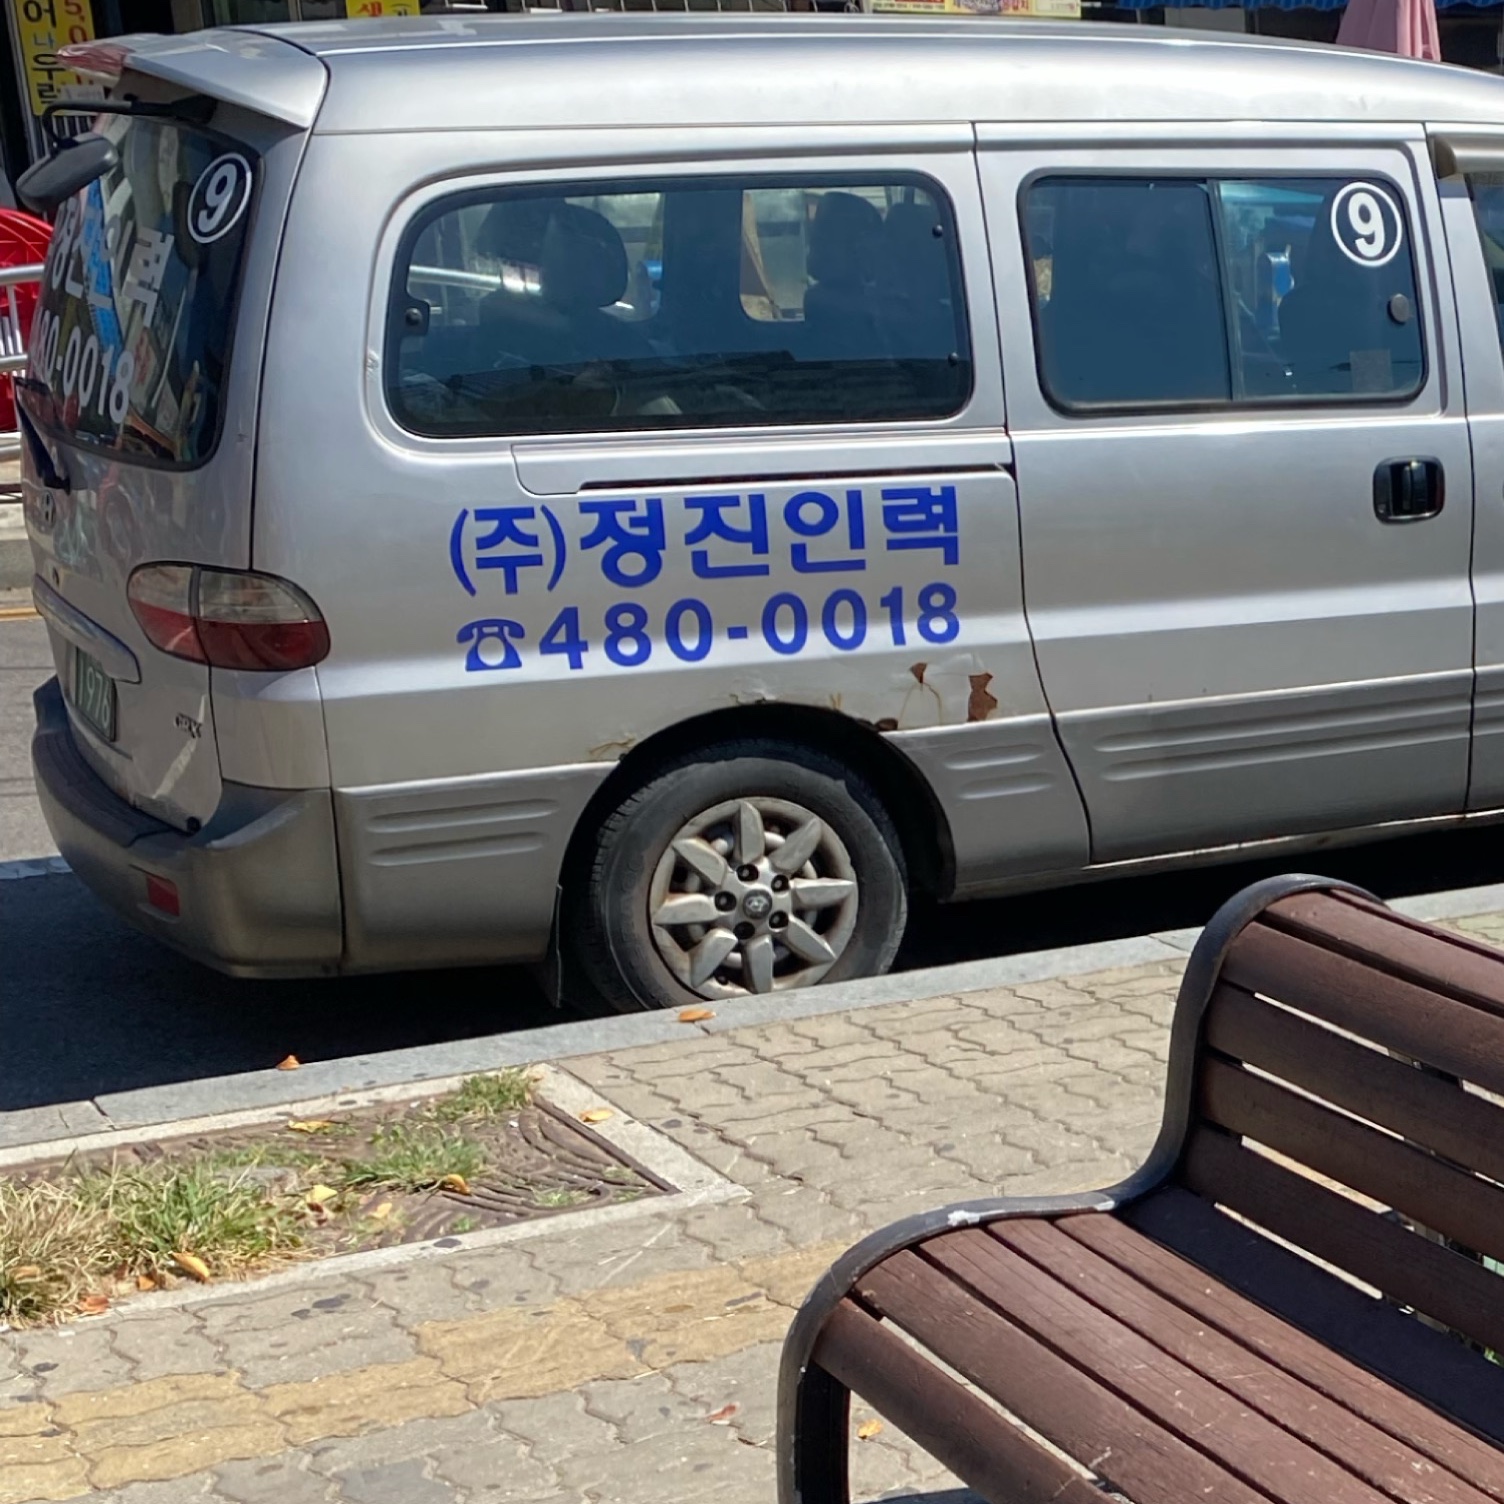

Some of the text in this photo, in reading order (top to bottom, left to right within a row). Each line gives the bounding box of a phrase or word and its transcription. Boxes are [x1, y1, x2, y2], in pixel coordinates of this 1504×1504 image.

[197, 162, 238, 234] 9
[1347, 191, 1386, 259] 9
[448, 485, 960, 597] (주)정진인력
[537, 581, 961, 670] 480-0018
[78, 657, 110, 730] 1976
